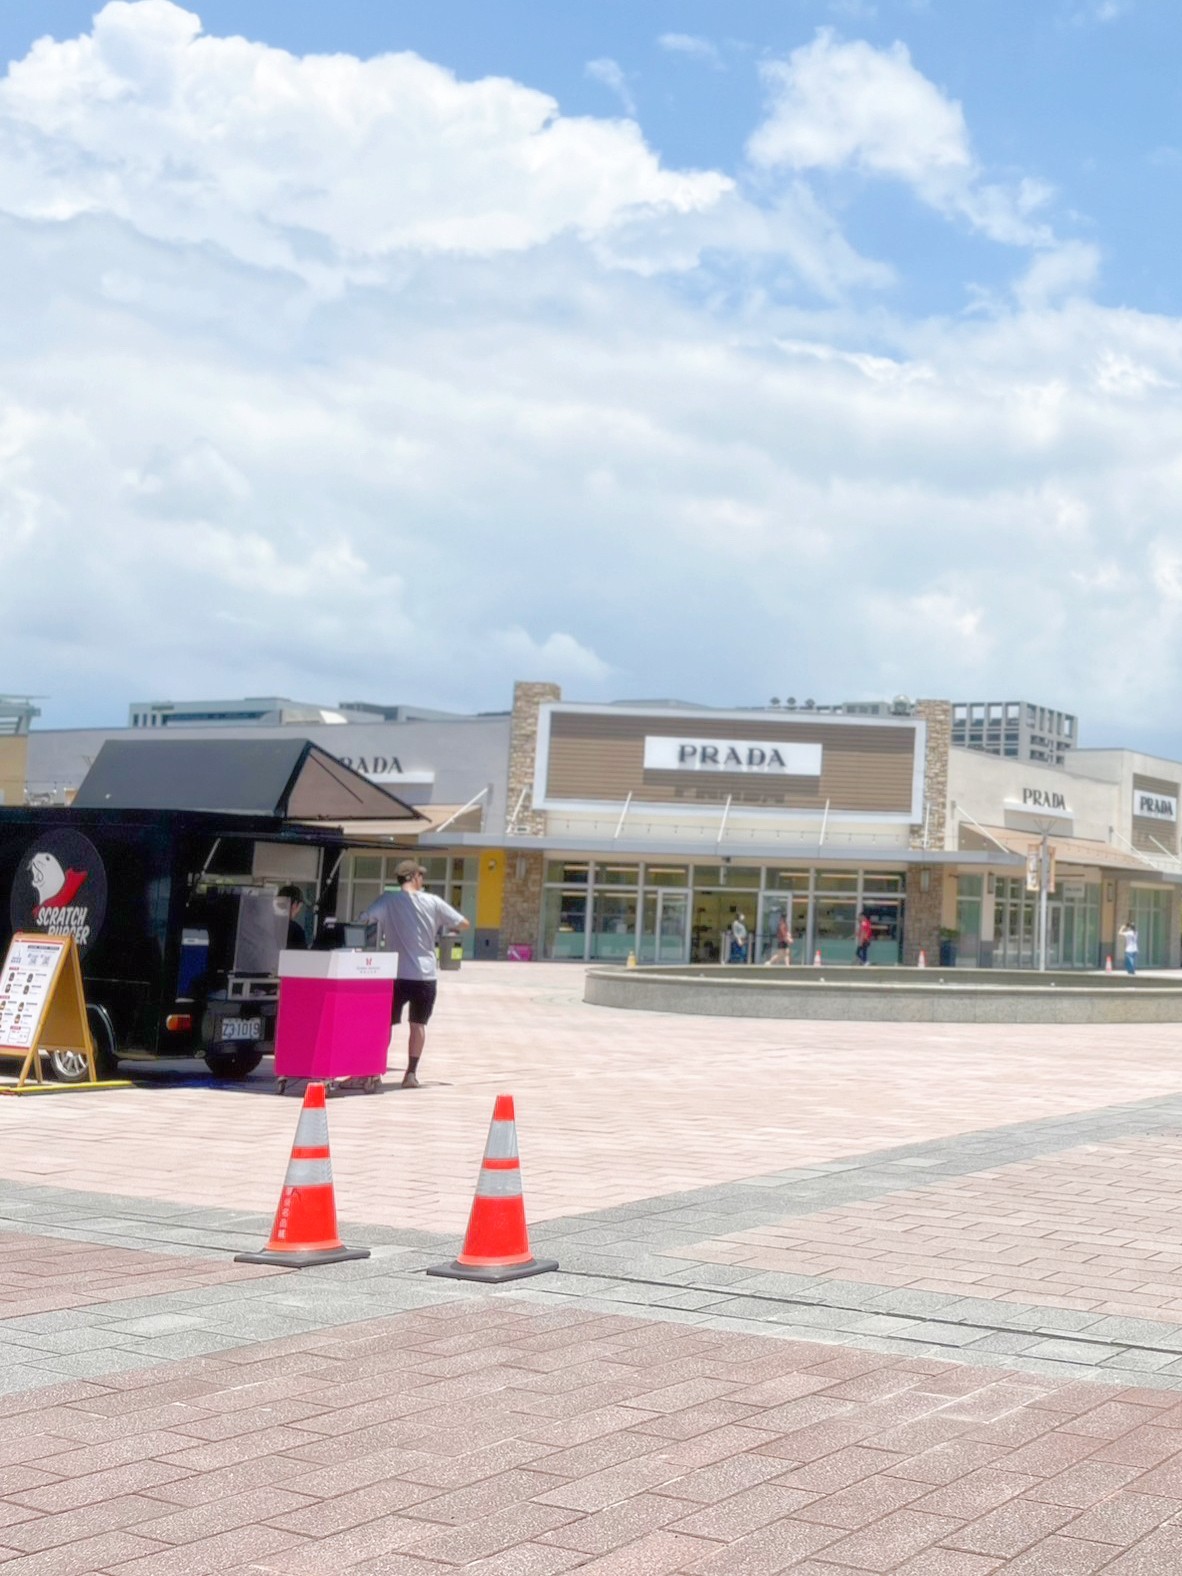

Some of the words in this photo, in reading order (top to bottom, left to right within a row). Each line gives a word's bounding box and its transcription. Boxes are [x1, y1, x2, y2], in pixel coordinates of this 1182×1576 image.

[677, 743, 787, 768] PRADA
[1022, 787, 1066, 810] PRADA
[1139, 795, 1173, 815] PRADA
[36, 906, 89, 926] SCRATCH
